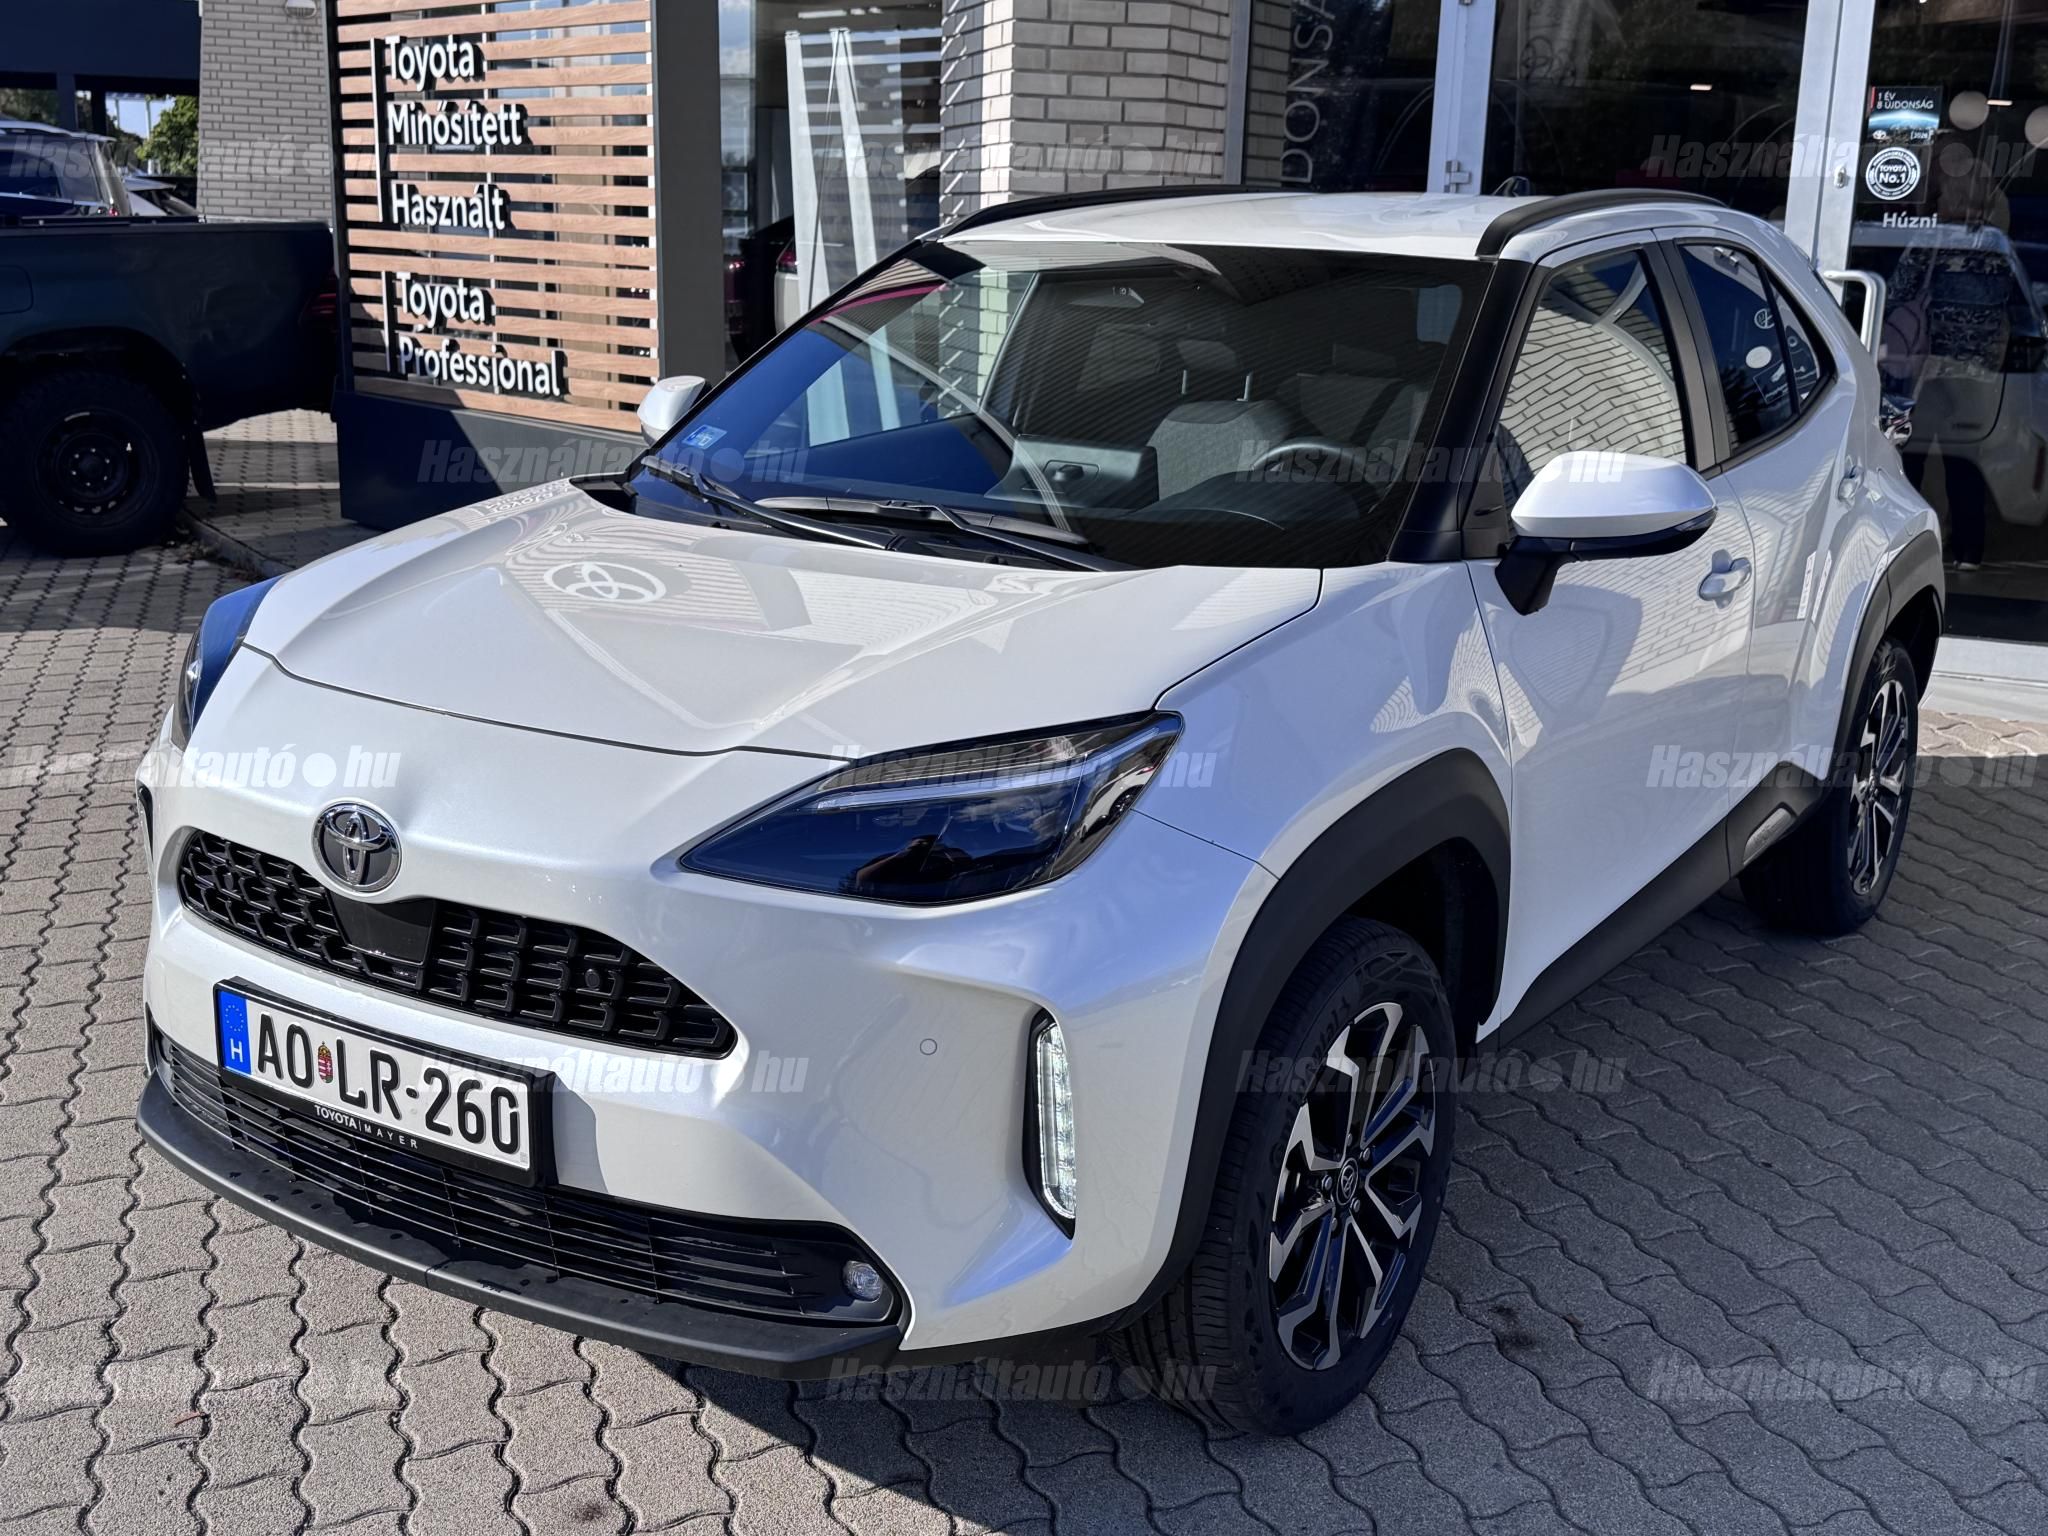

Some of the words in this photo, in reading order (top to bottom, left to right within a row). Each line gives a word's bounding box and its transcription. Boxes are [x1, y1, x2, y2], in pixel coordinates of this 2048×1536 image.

[383, 33, 475, 93] Toyota
[1884, 90, 1897, 101] ÉV
[1884, 97, 1934, 110] ÚJDONSÁG
[386, 101, 524, 146] Minősített
[1879, 164, 1907, 172] TOYOTA
[1879, 172, 1907, 184] No.1
[390, 182, 506, 231] Használt
[1882, 211, 1938, 229] Húzni
[395, 271, 486, 329] Toyota
[399, 336, 562, 397] Professional
[229, 1037, 244, 1063] H
[335, 1036, 522, 1156] LR-260
[314, 1104, 357, 1130] TOYOTA
[364, 1124, 419, 1150] MAYER
